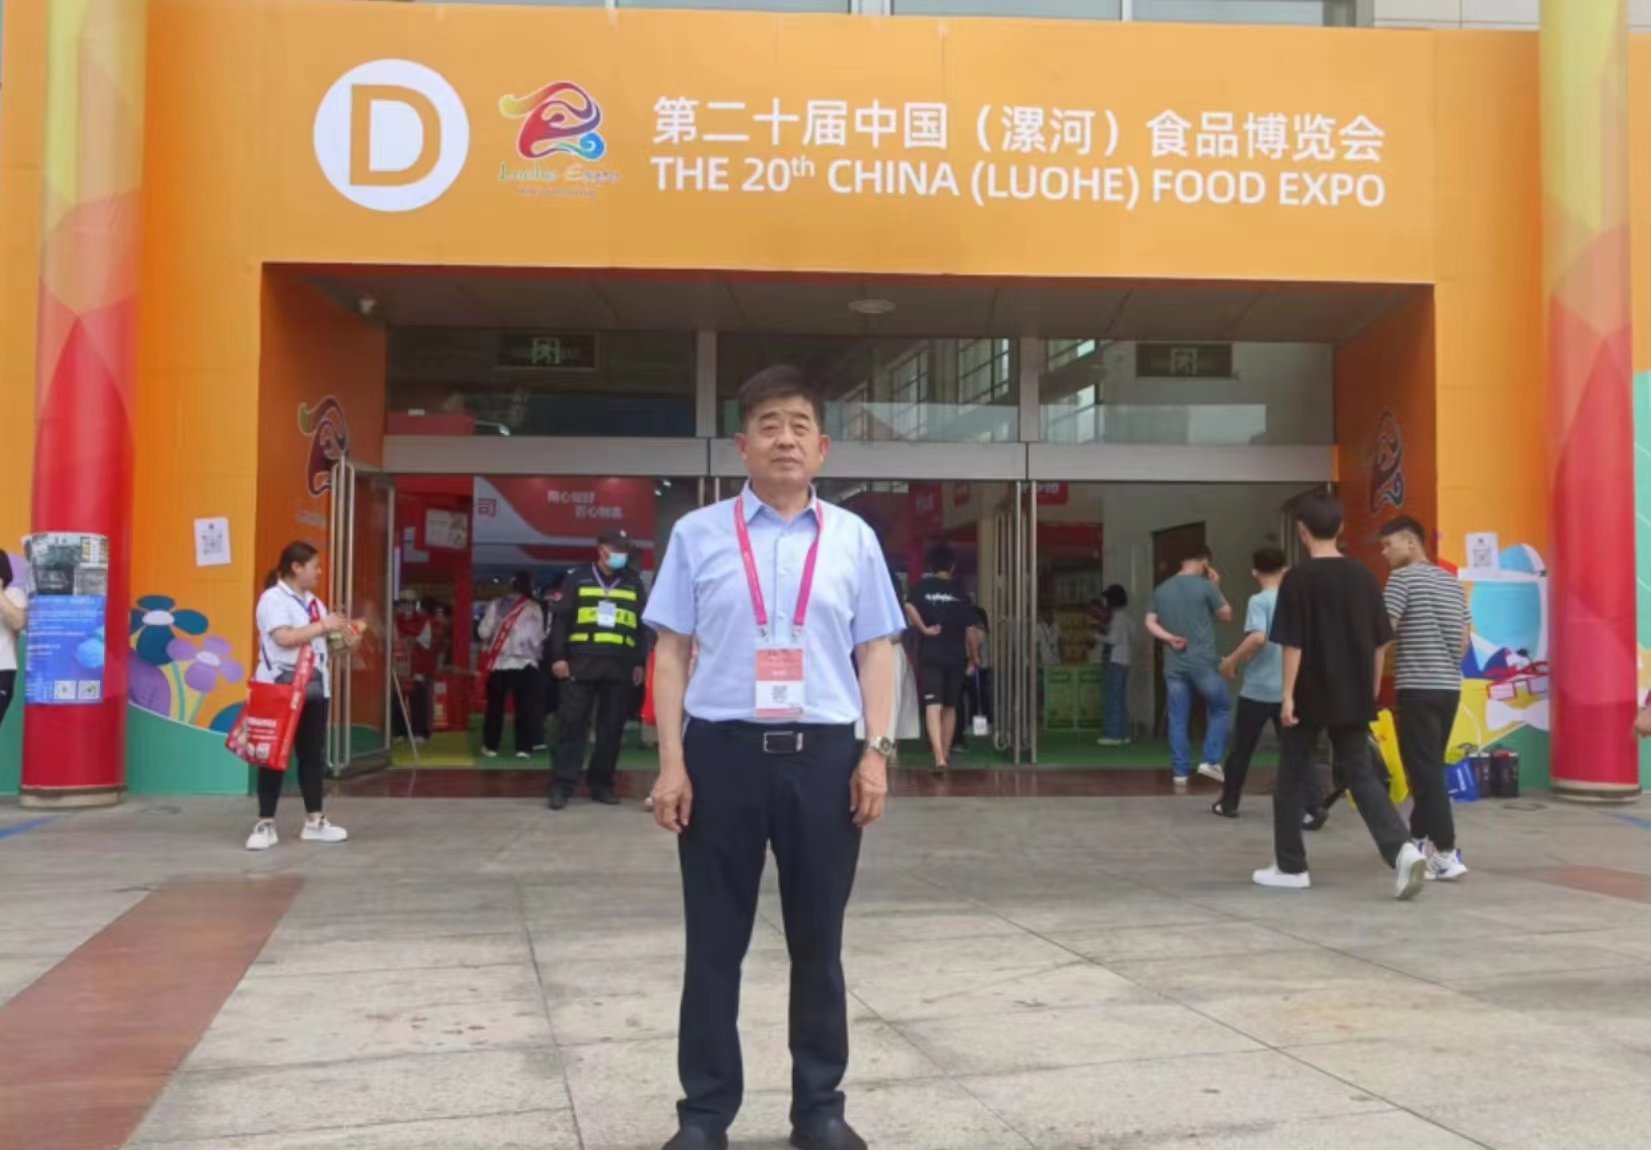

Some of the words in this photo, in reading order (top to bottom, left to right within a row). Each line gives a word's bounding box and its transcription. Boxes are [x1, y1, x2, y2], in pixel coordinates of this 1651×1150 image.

[349, 83, 443, 188] D
[653, 96, 1385, 163] 第二十届中国（漯河）食品博览会
[650, 156, 729, 191] THE
[742, 156, 815, 192] 20th
[828, 159, 960, 196] CHINA
[971, 161, 1140, 210] (LUOHE)
[1152, 168, 1267, 204] FOOD
[1279, 171, 1386, 207] EXPO
